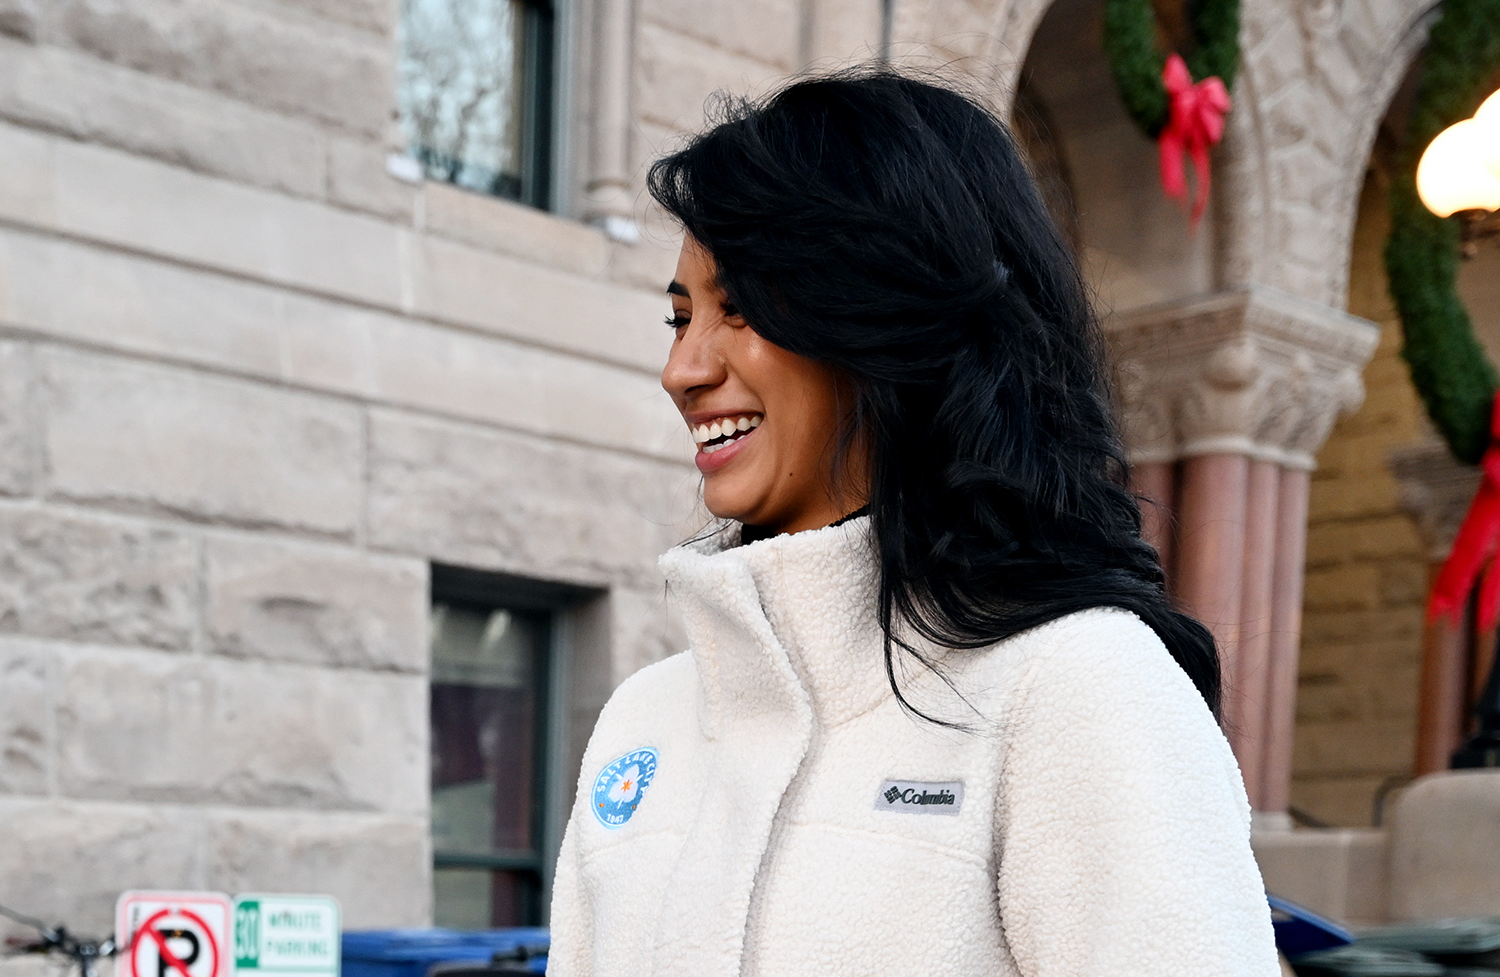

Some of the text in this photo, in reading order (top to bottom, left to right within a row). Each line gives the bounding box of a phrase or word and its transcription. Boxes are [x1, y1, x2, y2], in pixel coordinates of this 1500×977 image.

[597, 762, 621, 792] SALT
[625, 752, 653, 764] LAKE
[901, 788, 955, 805] Columbia
[268, 911, 322, 928] MINUTE
[267, 940, 329, 957] PARKING
